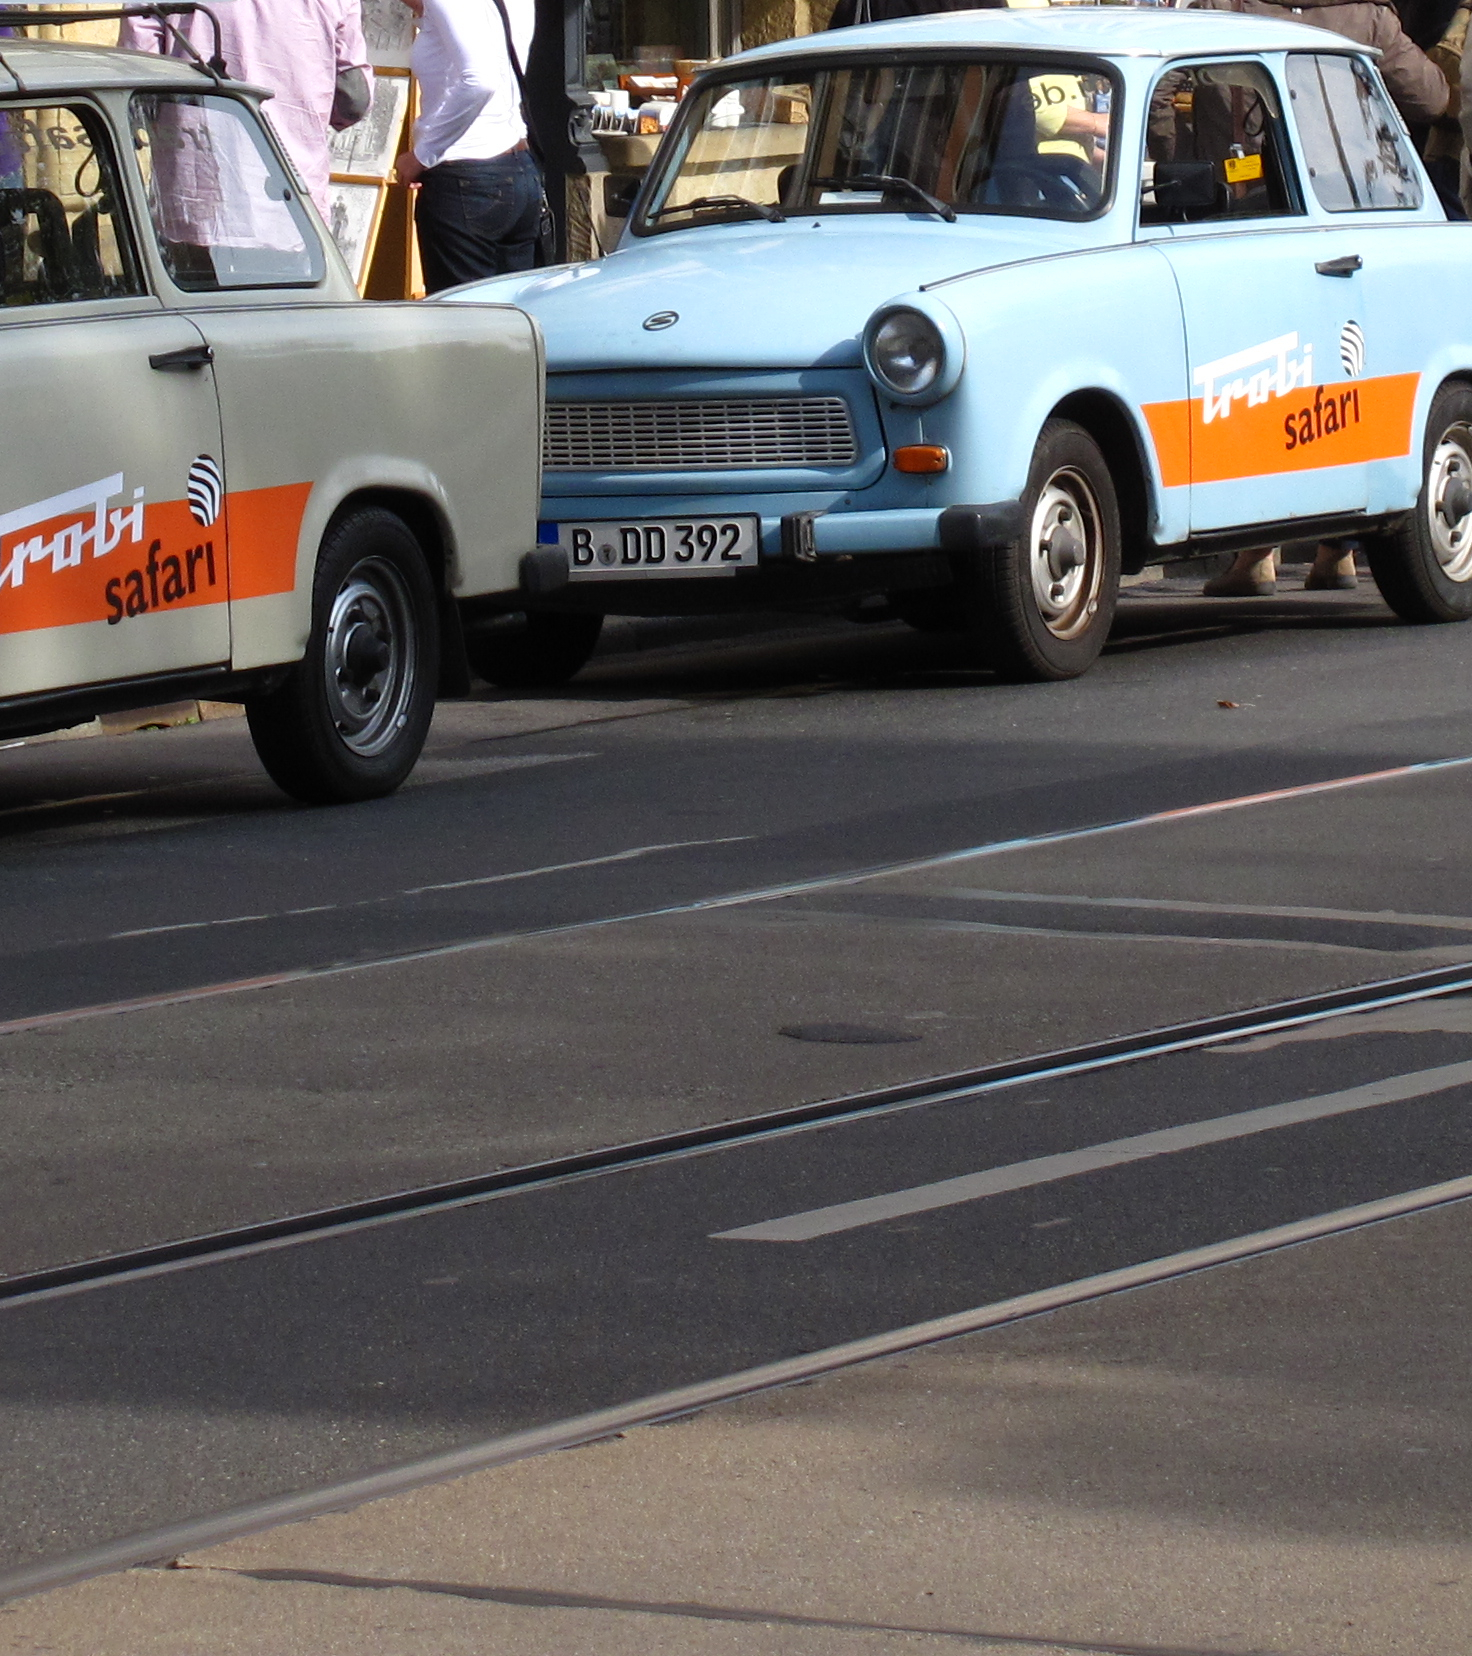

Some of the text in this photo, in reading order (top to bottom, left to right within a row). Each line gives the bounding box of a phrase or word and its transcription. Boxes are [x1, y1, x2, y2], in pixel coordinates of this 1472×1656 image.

[1284, 385, 1360, 450] safari
[572, 528, 595, 565] B
[105, 539, 216, 625] safari
